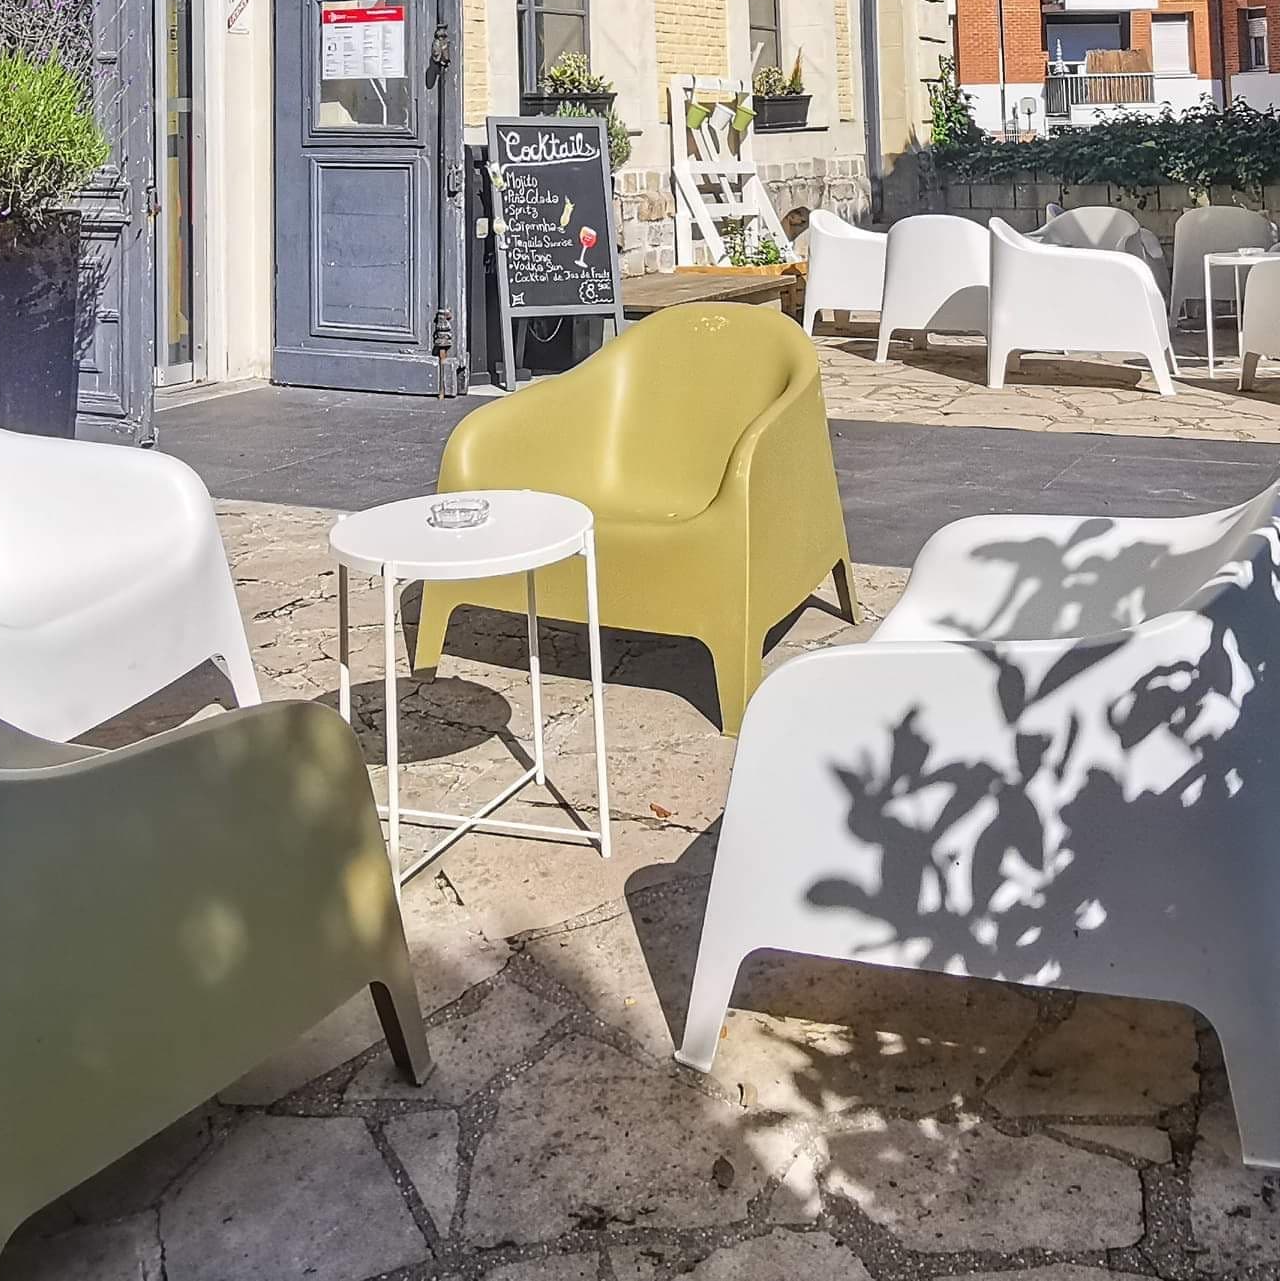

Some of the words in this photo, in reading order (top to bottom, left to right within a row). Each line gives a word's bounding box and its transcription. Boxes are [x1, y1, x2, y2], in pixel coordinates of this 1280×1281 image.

[499, 131, 597, 163] Cocktails
[506, 171, 538, 195] Mojito
[511, 234, 543, 253] Tequila
[513, 248, 530, 261] Gin
[512, 261, 544, 272] Vodka
[515, 271, 549, 283] Cocktail
[553, 272, 564, 282] de
[580, 269, 591, 279] de
